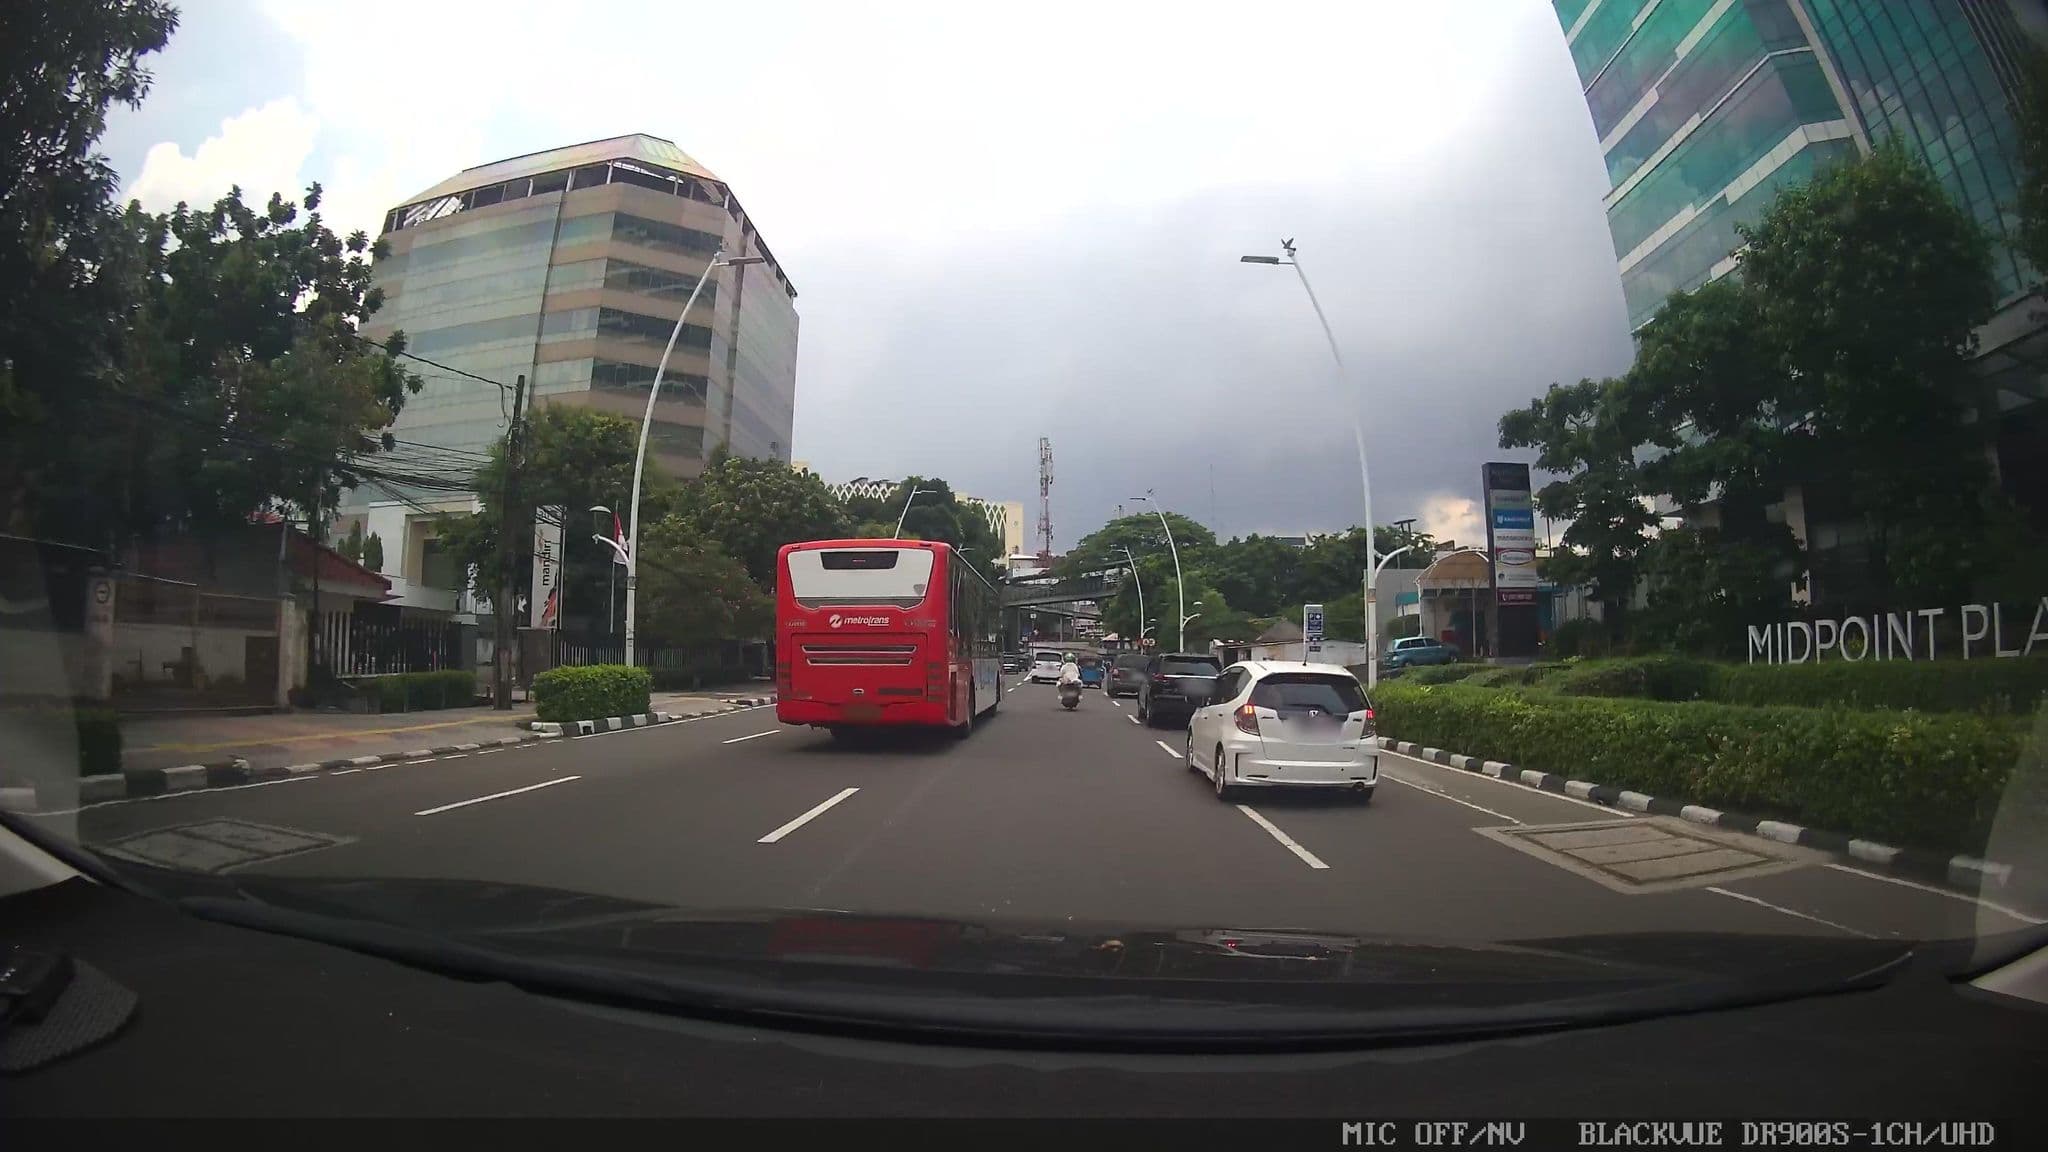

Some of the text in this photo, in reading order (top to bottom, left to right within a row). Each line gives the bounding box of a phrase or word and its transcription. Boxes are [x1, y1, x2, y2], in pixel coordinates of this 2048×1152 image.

[542, 540, 552, 586] mandiri
[844, 616, 890, 627] metrotrans
[1747, 596, 2048, 665] MIDPOINT PLA
